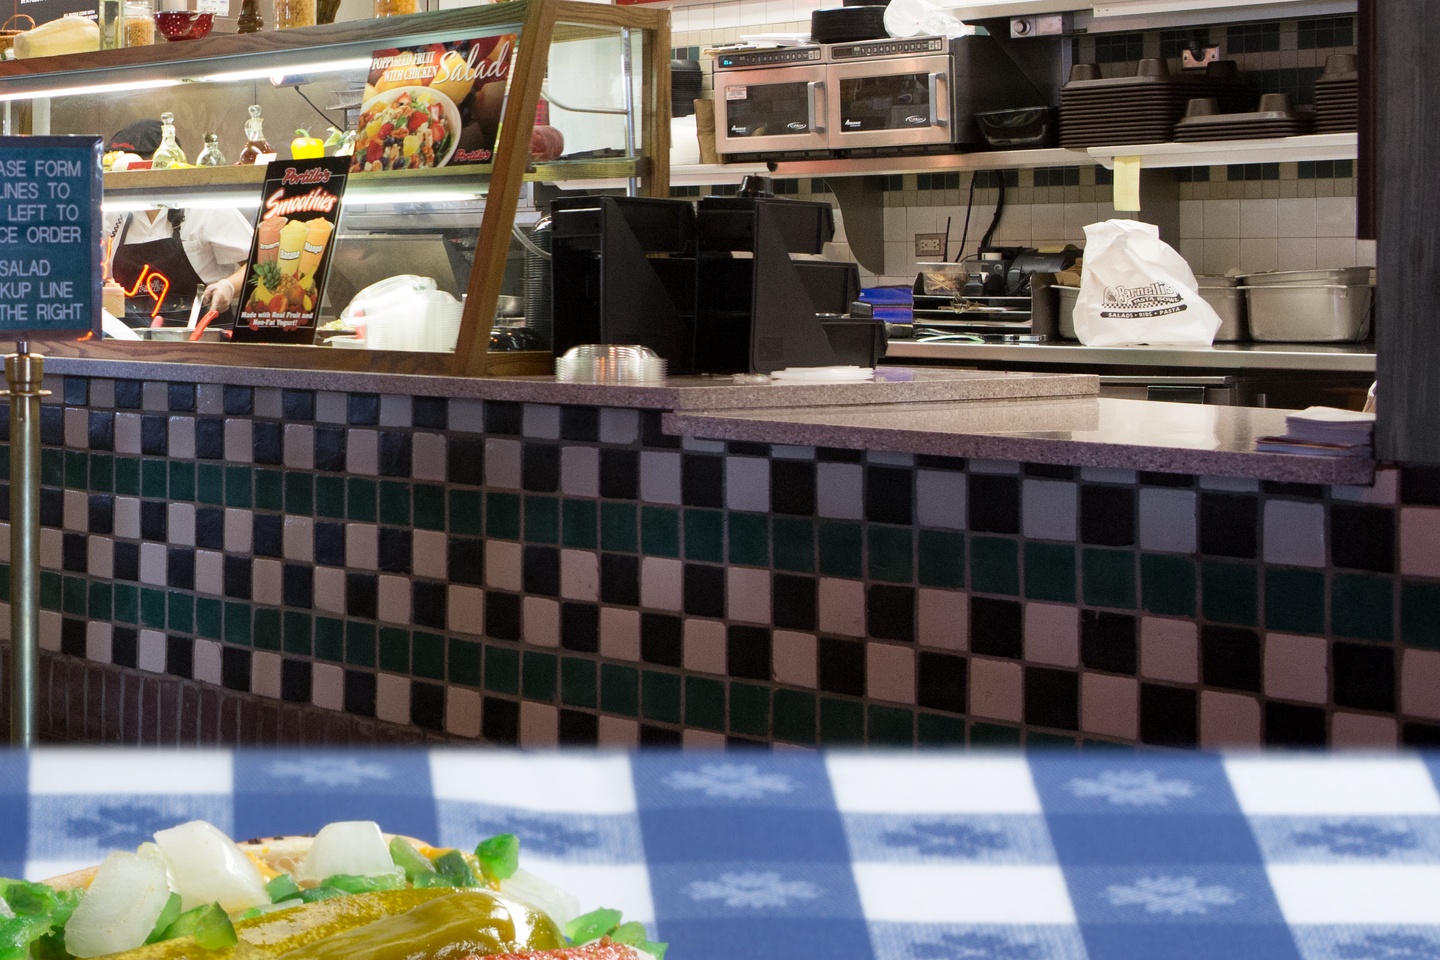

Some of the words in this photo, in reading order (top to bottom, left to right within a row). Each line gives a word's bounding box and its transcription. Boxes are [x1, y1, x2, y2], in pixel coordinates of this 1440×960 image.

[372, 54, 412, 70] POPPYSEED
[413, 51, 436, 65] FRUIT
[433, 40, 510, 84] Salad
[384, 70, 403, 82] WITH
[403, 65, 439, 81] CHICKEN
[454, 149, 491, 161] Portillo's
[35, 160, 81, 177] FORM
[282, 167, 333, 185] Portillo's
[47, 182, 70, 199] TO
[263, 186, 338, 220] Smoothies
[8, 204, 47, 221] LEFT
[56, 204, 79, 221] TO
[26, 226, 81, 243] ORDER
[279, 249, 301, 260] Banana
[304, 241, 323, 255] Mango
[40, 281, 73, 298] LINE
[36, 303, 83, 320] RIGHT
[286, 311, 301, 319] Fruit
[1160, 306, 1180, 315] PASTA
[276, 319, 298, 327] Yogurt!
